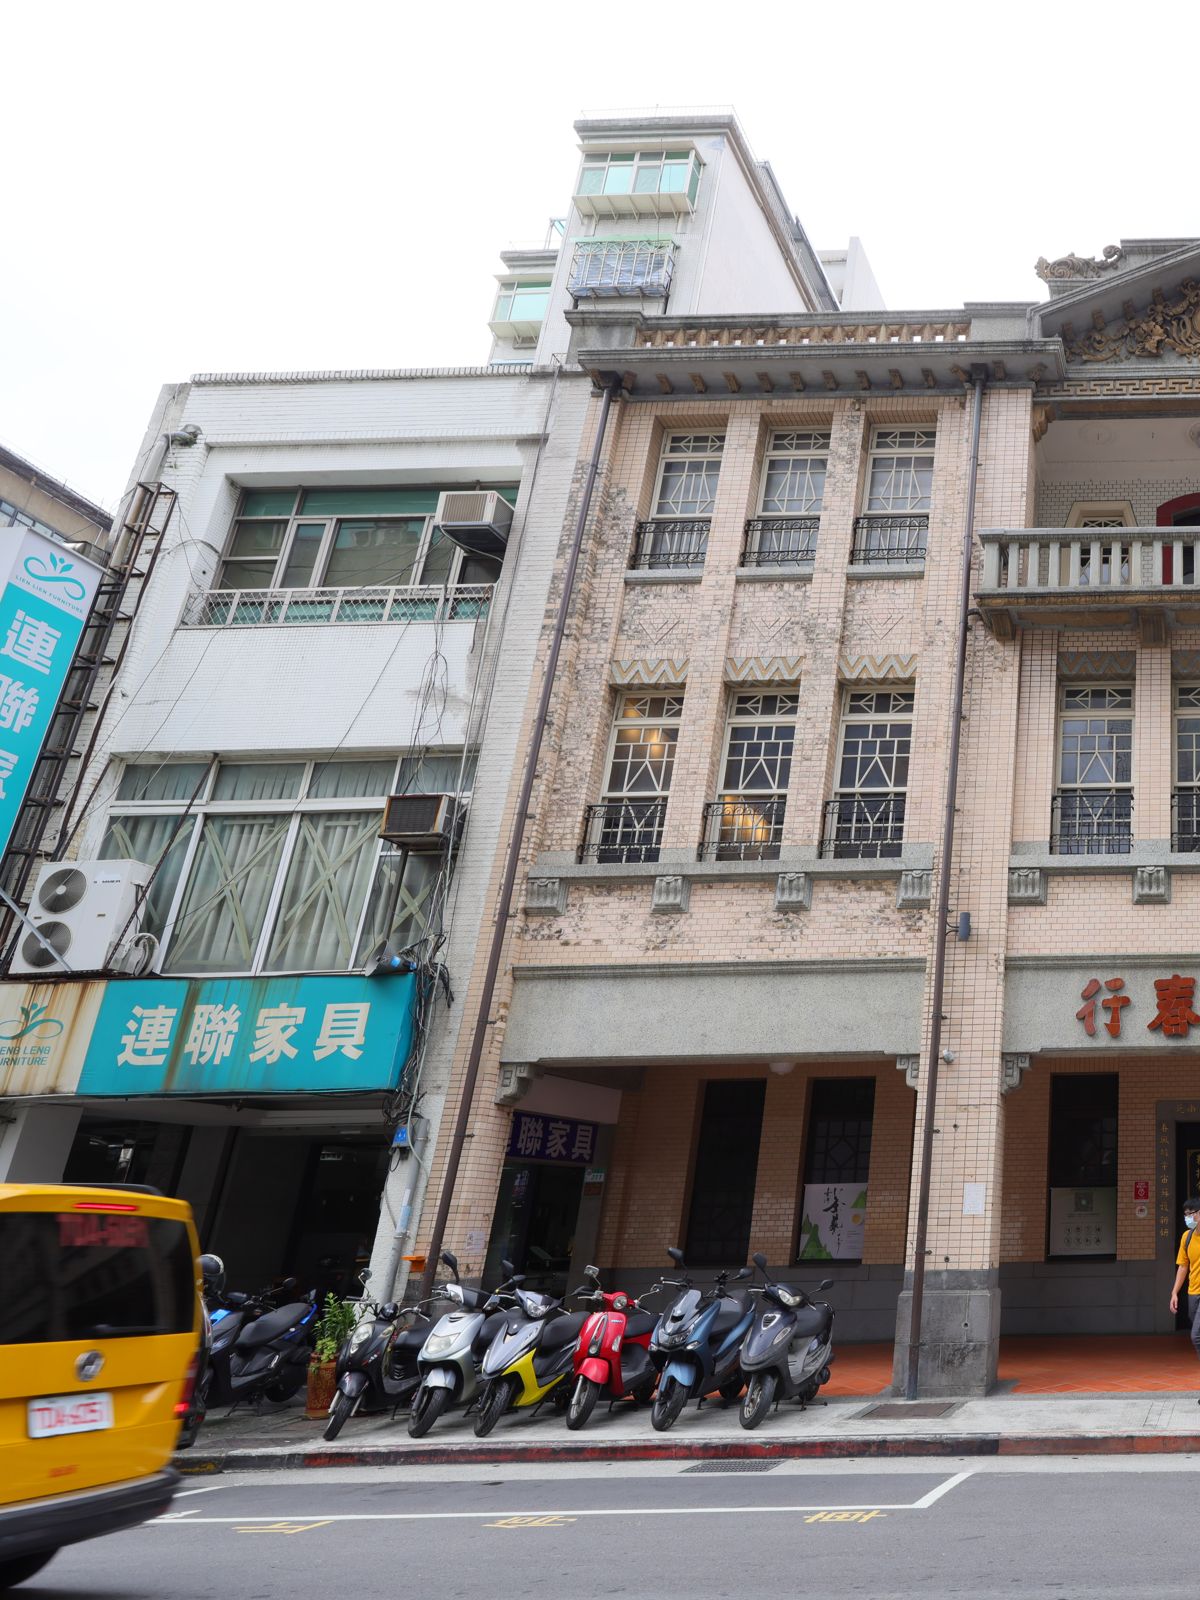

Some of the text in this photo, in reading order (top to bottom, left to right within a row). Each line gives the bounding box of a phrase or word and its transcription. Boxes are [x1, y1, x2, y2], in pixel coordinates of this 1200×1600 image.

[0, 609, 62, 801] 連聯
[116, 1002, 371, 1067] 連聯家具
[506, 1116, 593, 1160] 聯家具
